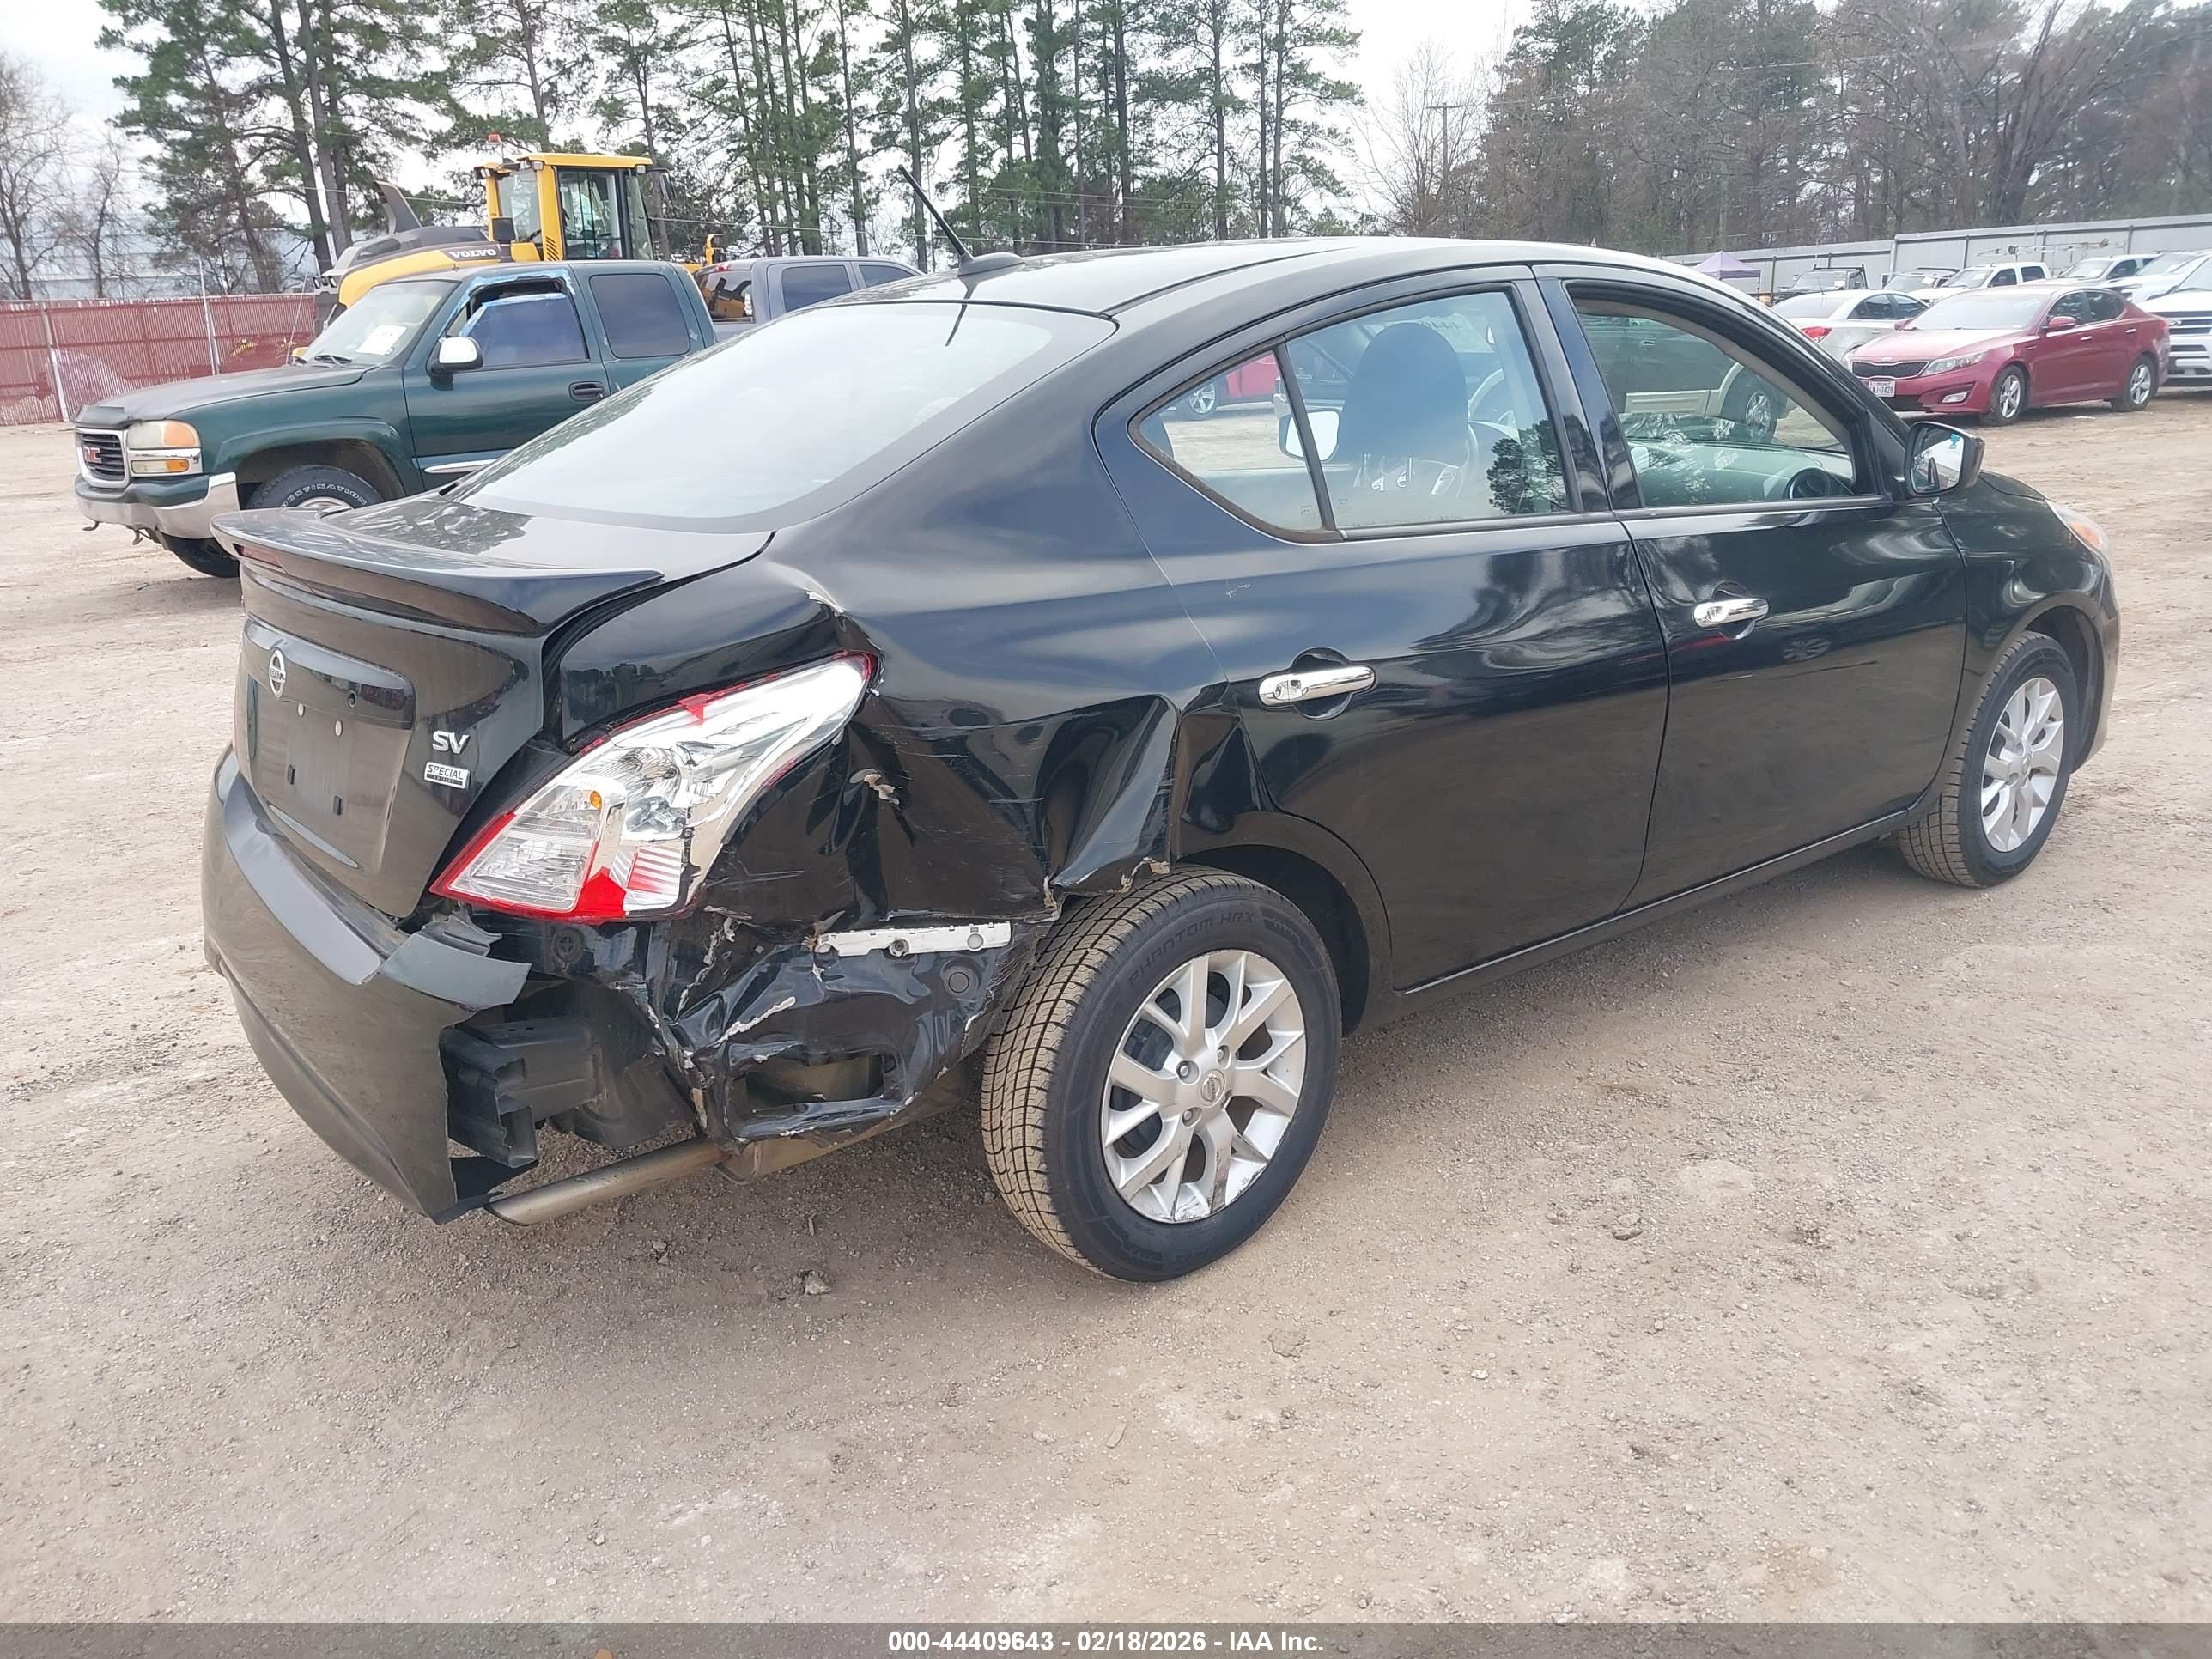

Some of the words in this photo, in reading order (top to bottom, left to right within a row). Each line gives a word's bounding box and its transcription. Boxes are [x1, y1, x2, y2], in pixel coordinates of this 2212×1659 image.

[449, 248, 497, 258] VOLVO
[432, 730, 471, 754] SV
[427, 764, 464, 781] SPECIAL
[1127, 919, 1213, 985] PHANTOM
[1219, 910, 1256, 924] HRX
